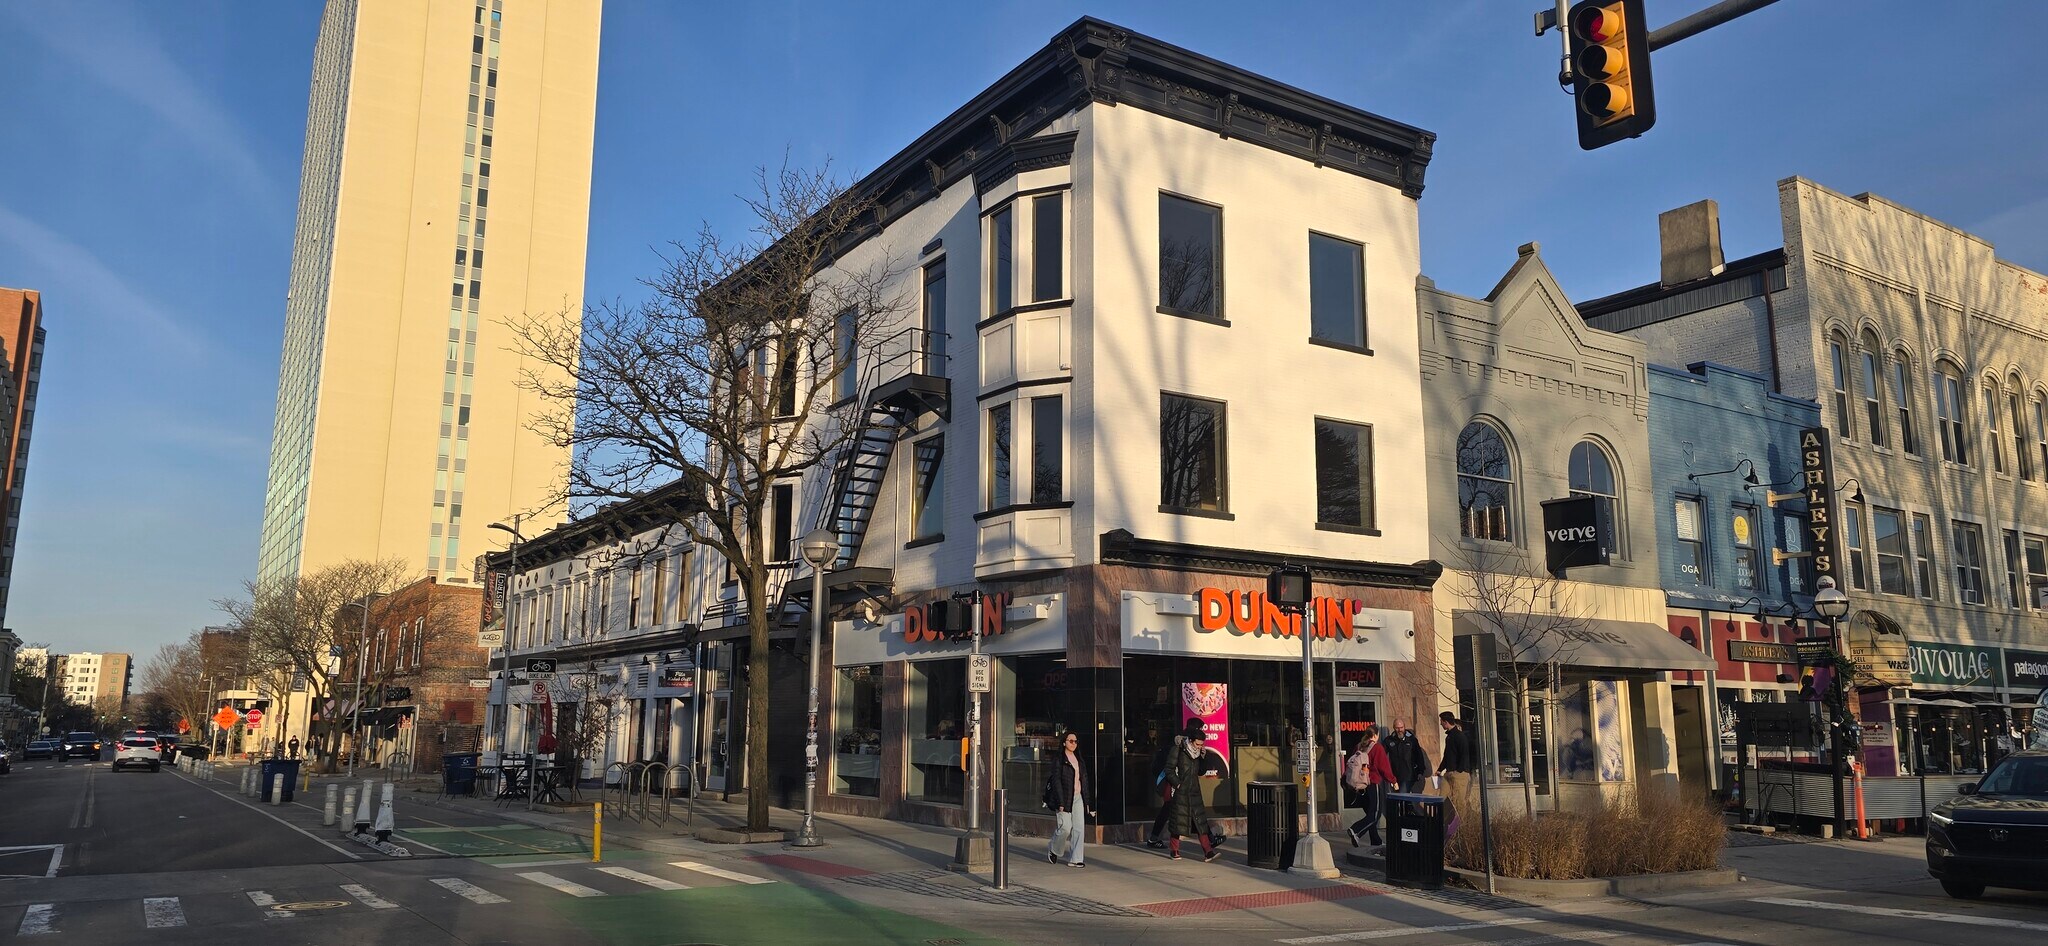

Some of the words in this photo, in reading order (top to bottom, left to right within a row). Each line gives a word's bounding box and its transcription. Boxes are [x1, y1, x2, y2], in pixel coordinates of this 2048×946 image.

[1802, 432, 1831, 571] ASHLEY'S
[1547, 526, 1596, 542] verve
[1680, 564, 1700, 574] OGA
[1789, 576, 1805, 586] OGA
[495, 573, 505, 606] DISTRICT
[905, 590, 1010, 643] DUN'
[1553, 627, 1628, 645] verve
[1741, 646, 1790, 659] ASHLEY'S
[1909, 645, 1990, 680] BIVOUAC
[1044, 672, 1068, 687] OPE
[1340, 669, 1376, 683] OPEN
[1530, 714, 1541, 722] rve
[1210, 723, 1225, 731] NEW
